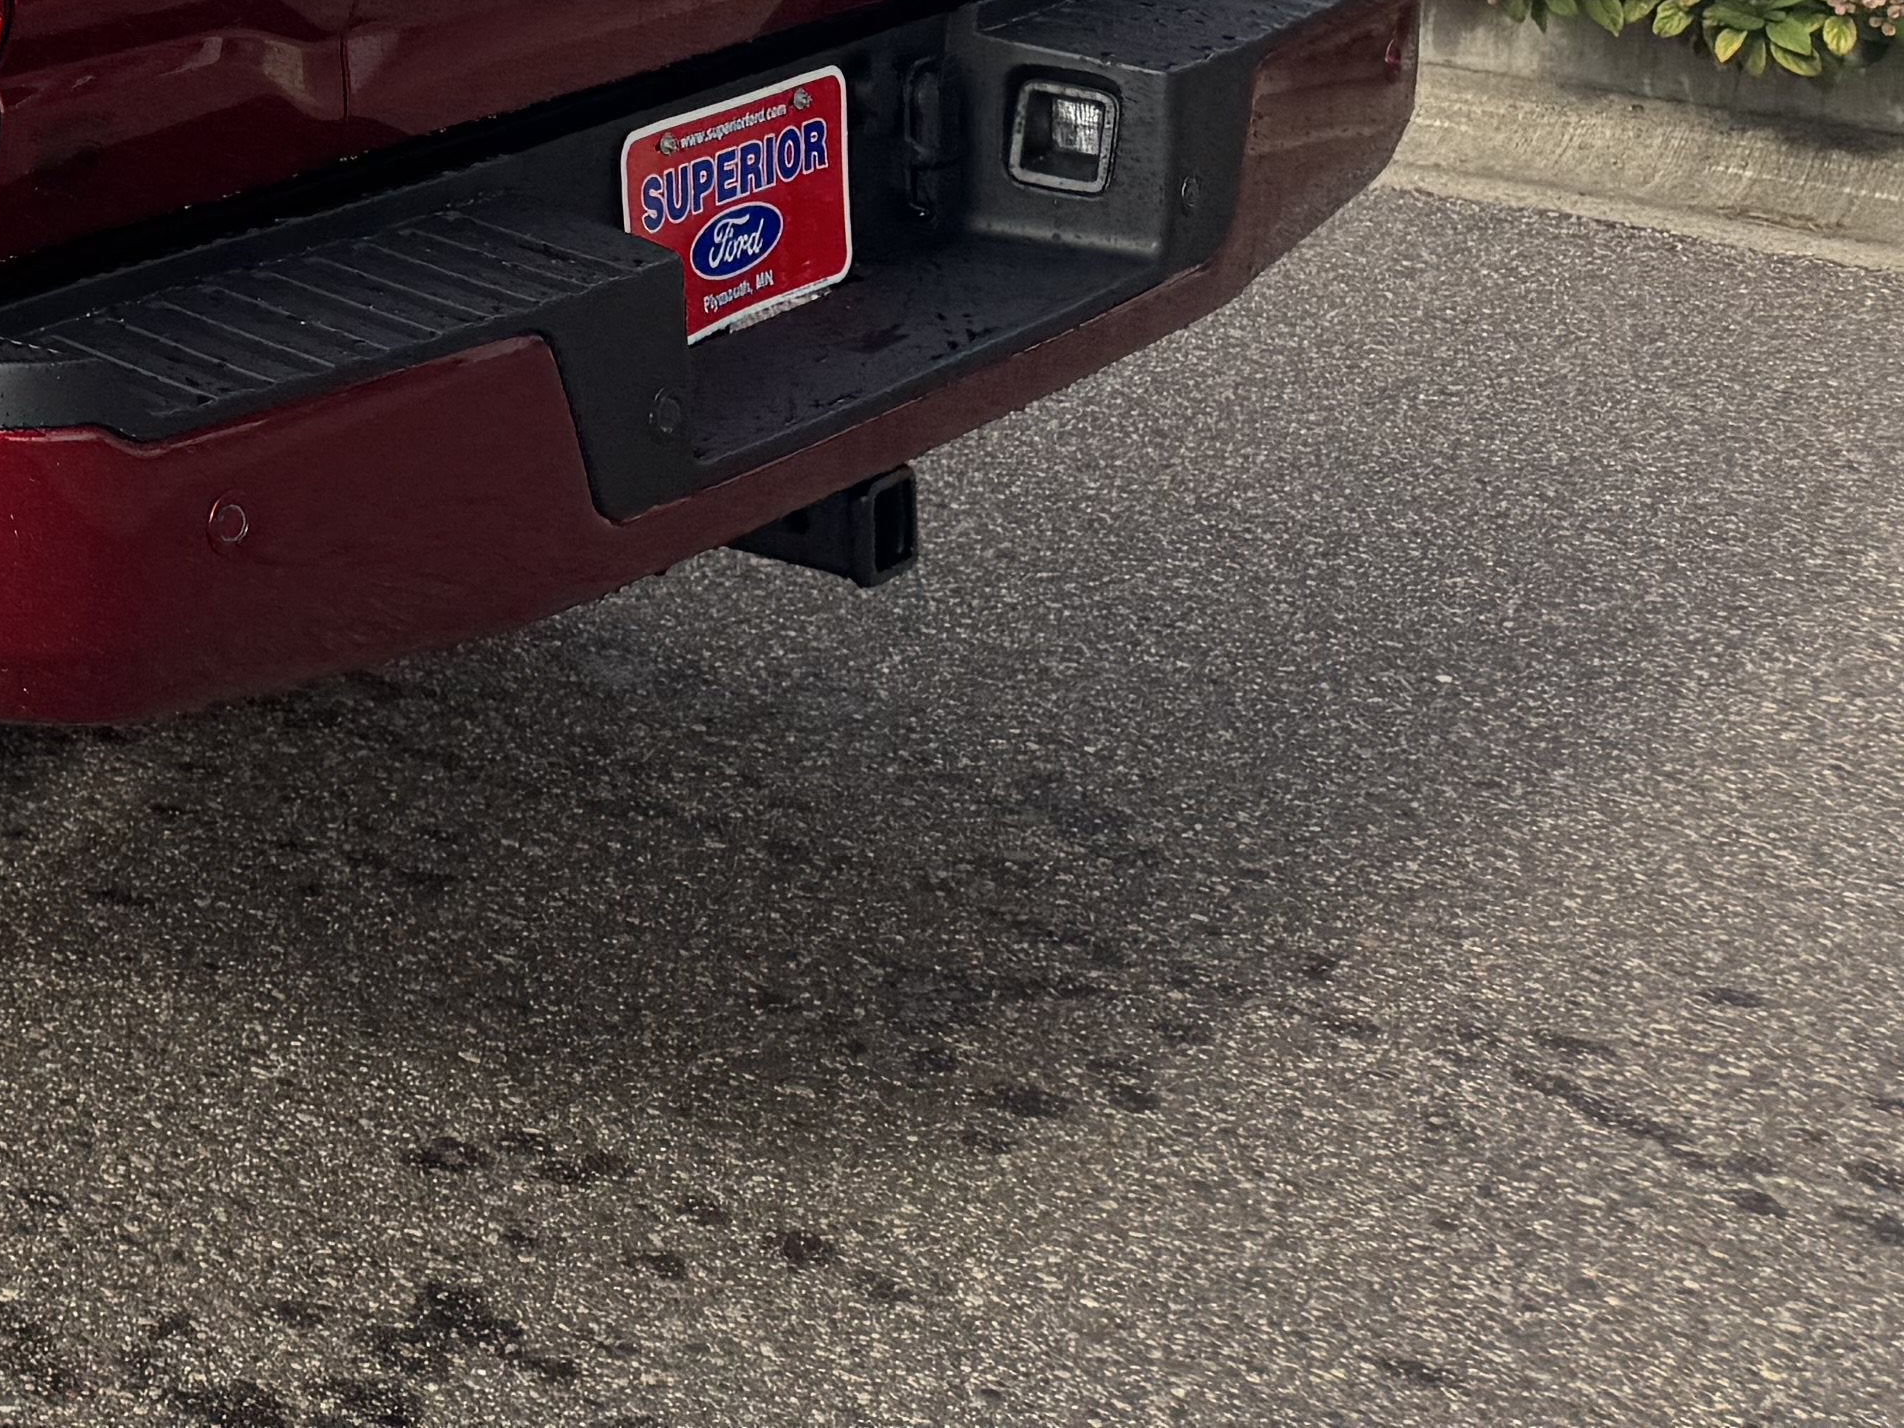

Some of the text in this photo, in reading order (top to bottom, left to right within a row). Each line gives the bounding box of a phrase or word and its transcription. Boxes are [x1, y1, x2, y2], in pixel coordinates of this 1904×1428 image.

[680, 104, 788, 148] www.superiorford.com
[641, 117, 828, 233] SUPERIOR
[707, 213, 765, 269] Ford
[703, 269, 775, 314] Plymouth, MN
